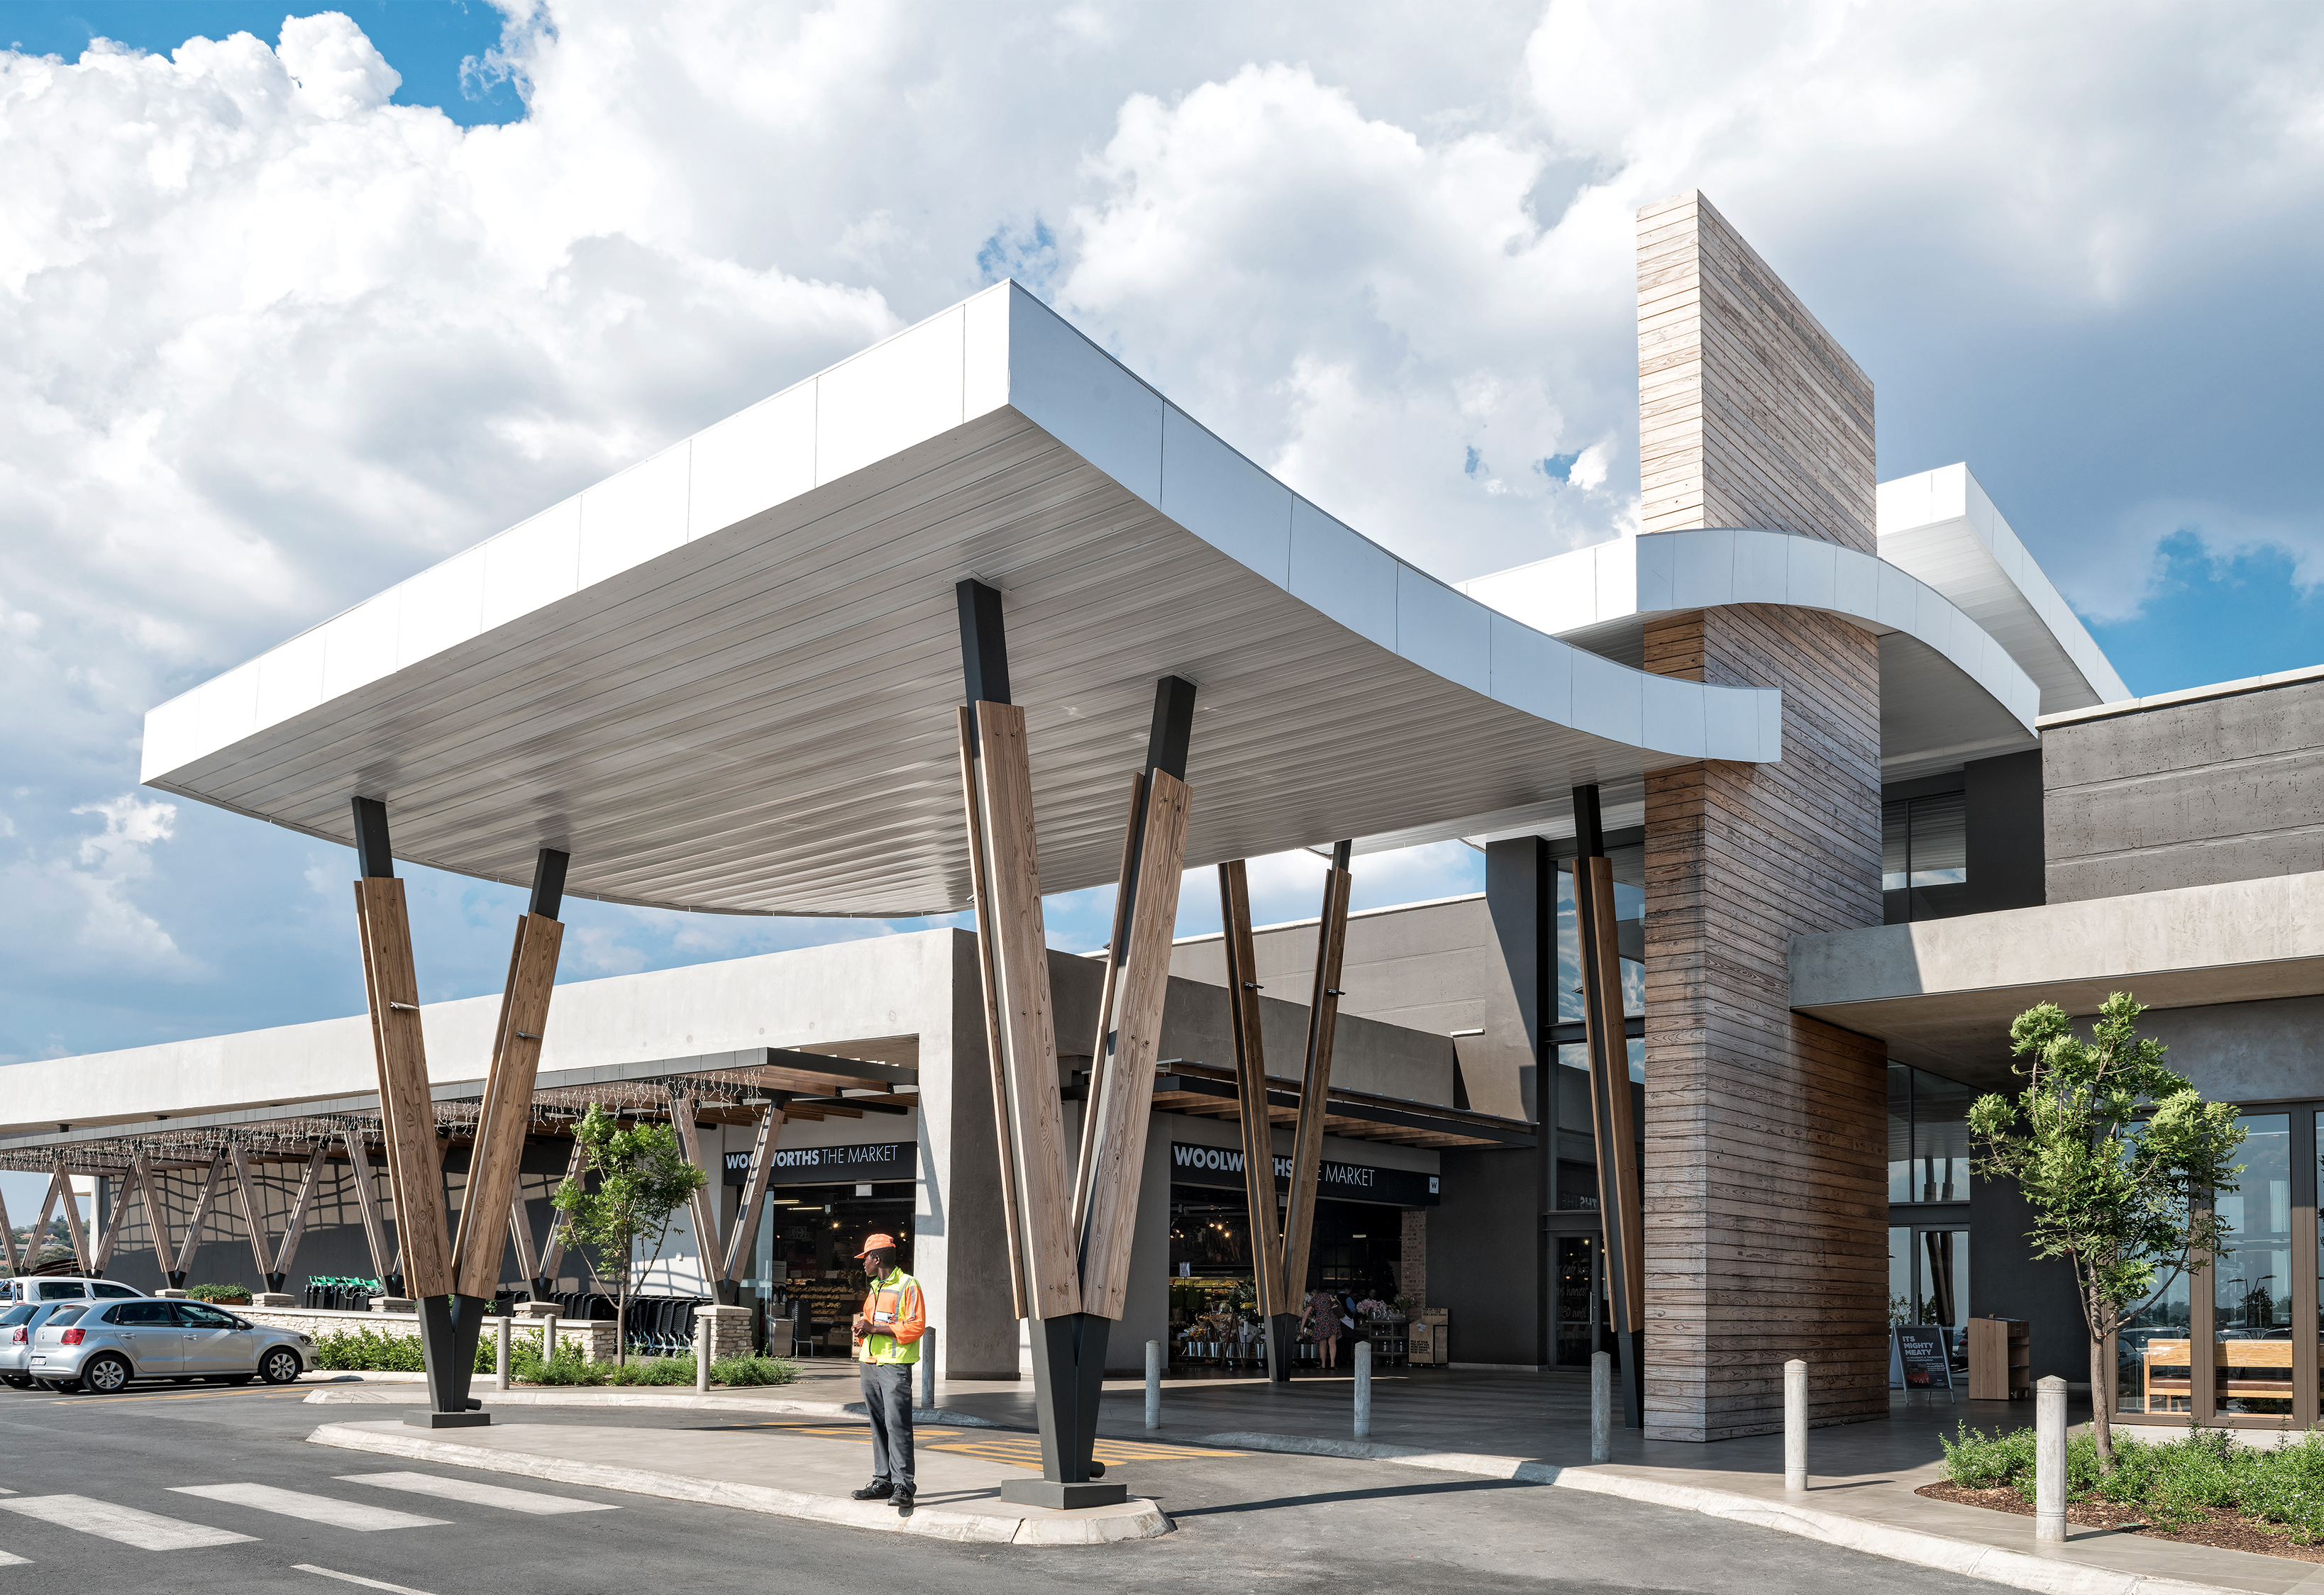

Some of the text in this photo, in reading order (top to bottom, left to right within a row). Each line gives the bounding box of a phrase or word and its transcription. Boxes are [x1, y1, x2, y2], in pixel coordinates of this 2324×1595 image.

[726, 1145, 898, 1169] WOORTHS THE MARKET
[1173, 1145, 1293, 1178] WOOLWHS
[1325, 1163, 1375, 1186] MARKET
